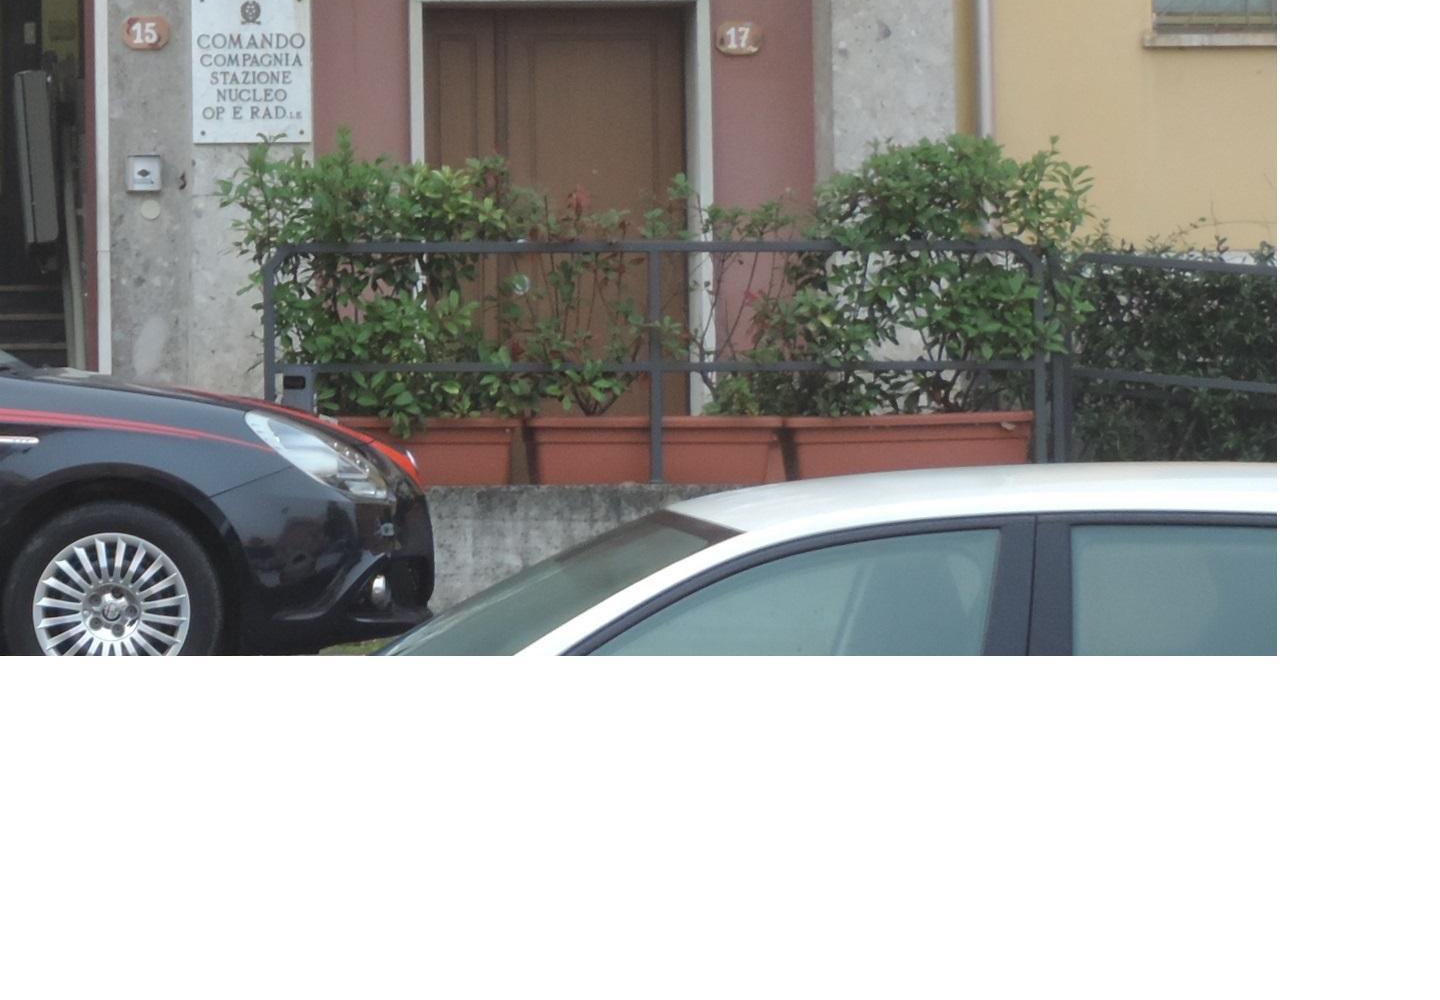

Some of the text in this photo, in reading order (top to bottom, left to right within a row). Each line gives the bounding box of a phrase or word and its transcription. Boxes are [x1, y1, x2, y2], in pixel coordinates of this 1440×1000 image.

[131, 22, 158, 44] 15
[726, 27, 750, 49] 17
[196, 33, 306, 49] COMANDO
[200, 53, 303, 68] COMPAGNIA
[210, 71, 292, 85] STAZIONE
[216, 88, 288, 102] NUCLEO
[202, 106, 226, 120] OP
[232, 106, 243, 120] E
